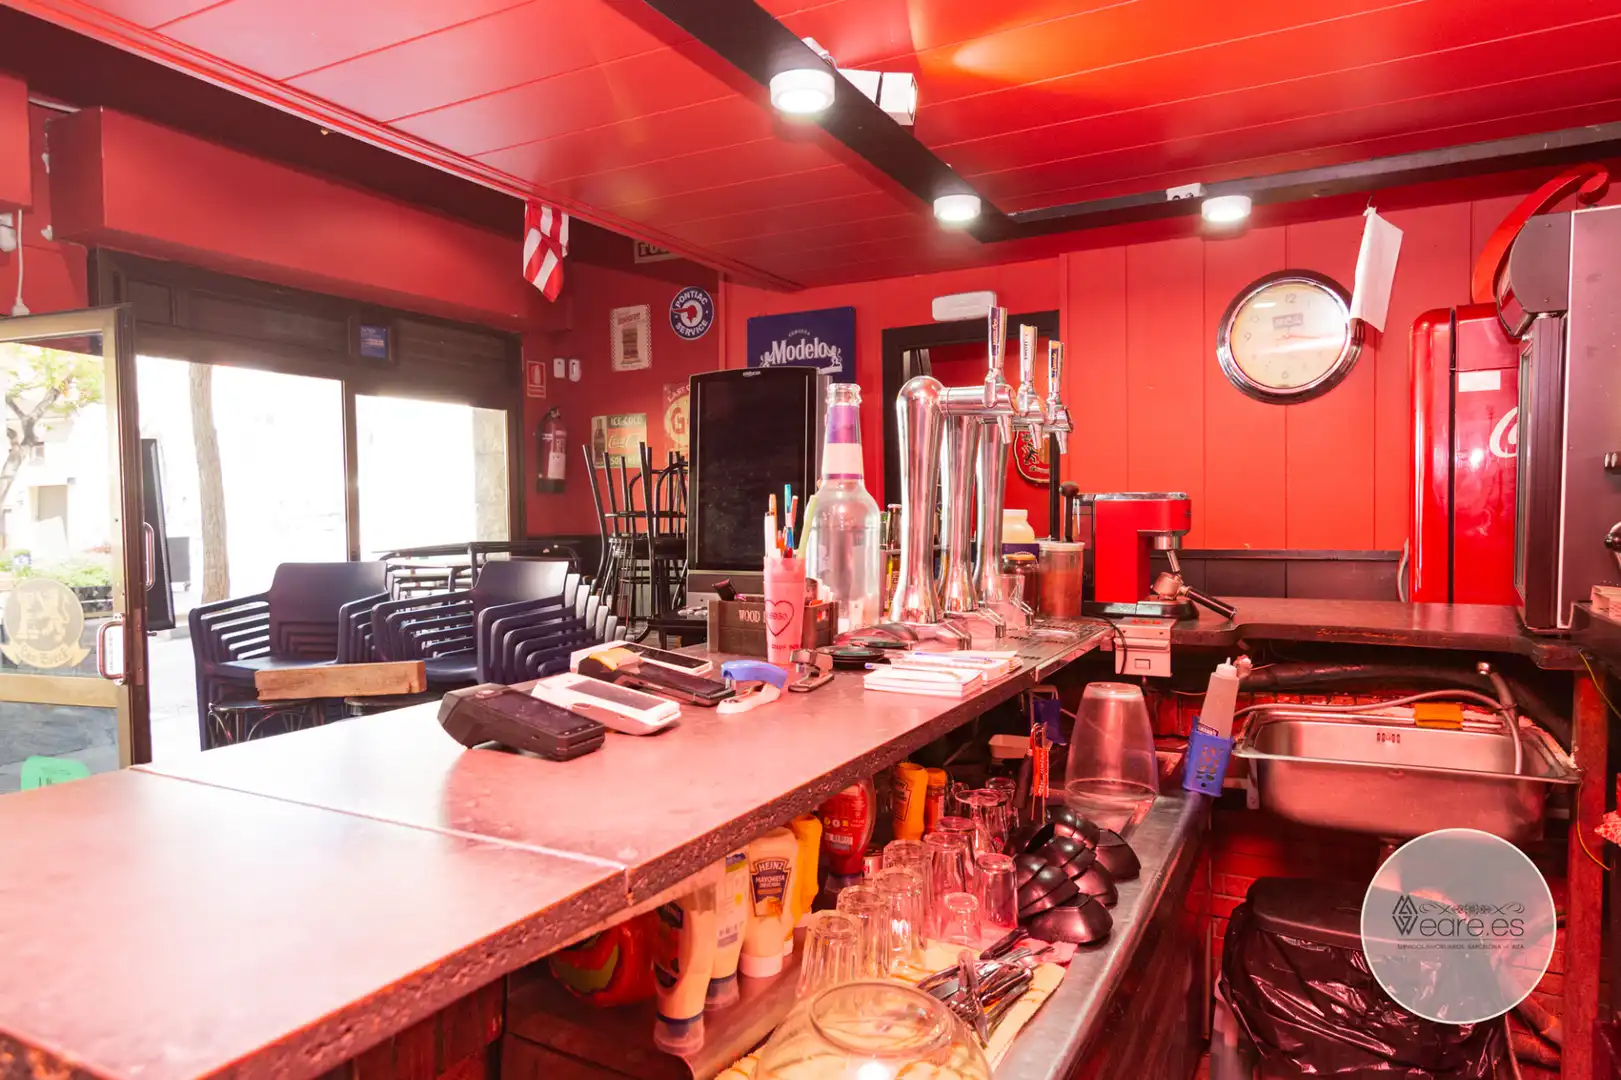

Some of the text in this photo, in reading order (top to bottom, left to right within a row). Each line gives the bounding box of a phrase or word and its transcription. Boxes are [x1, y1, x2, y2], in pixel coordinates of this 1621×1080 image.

[674, 290, 708, 308] PONTIAC
[1285, 293, 1296, 303] 12
[675, 319, 708, 336] SERVICE
[772, 337, 828, 365] Modelo
[739, 609, 760, 623] WOOD
[758, 861, 784, 872] HEINZ
